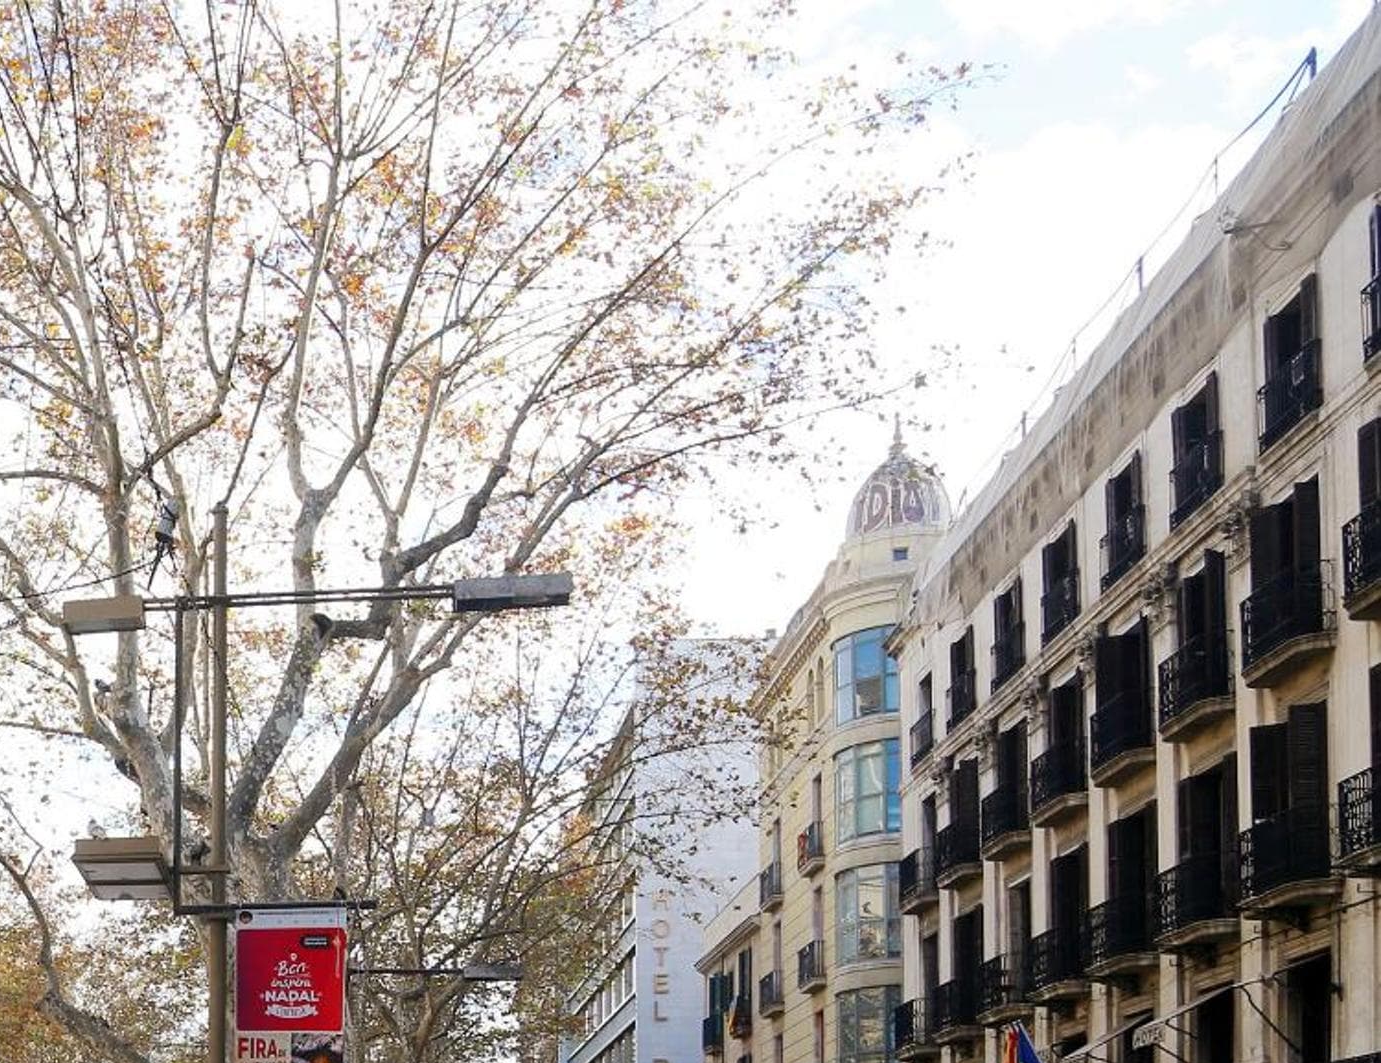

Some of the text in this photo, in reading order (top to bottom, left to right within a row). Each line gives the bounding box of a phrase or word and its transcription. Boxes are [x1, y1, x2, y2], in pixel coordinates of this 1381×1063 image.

[651, 890, 671, 1022] HOTEL
[265, 990, 320, 1002] NADAL
[238, 1038, 277, 1058] FIRA
